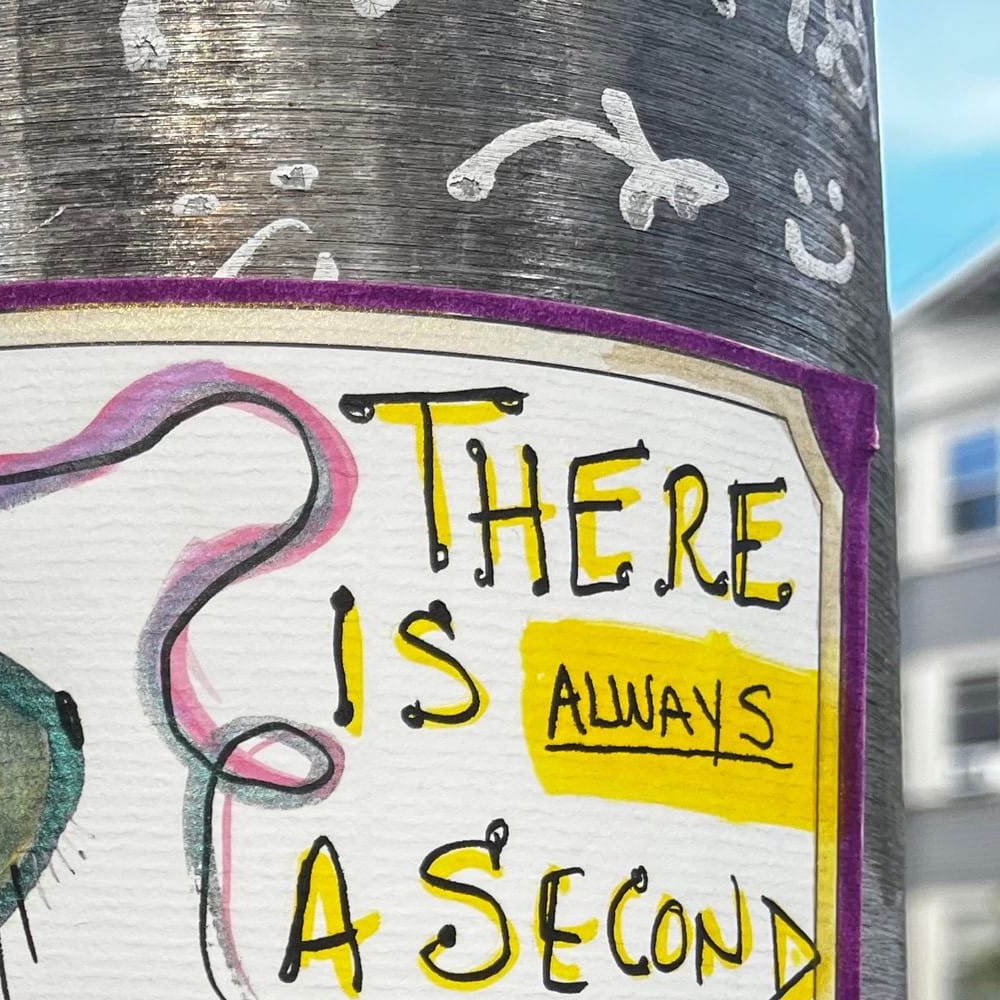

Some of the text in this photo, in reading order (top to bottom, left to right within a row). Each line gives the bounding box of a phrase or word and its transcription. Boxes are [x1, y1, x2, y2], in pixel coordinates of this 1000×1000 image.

[339, 386, 793, 609] THERE
[330, 585, 774, 766] IS ALWAYS
[279, 836, 363, 992] A
